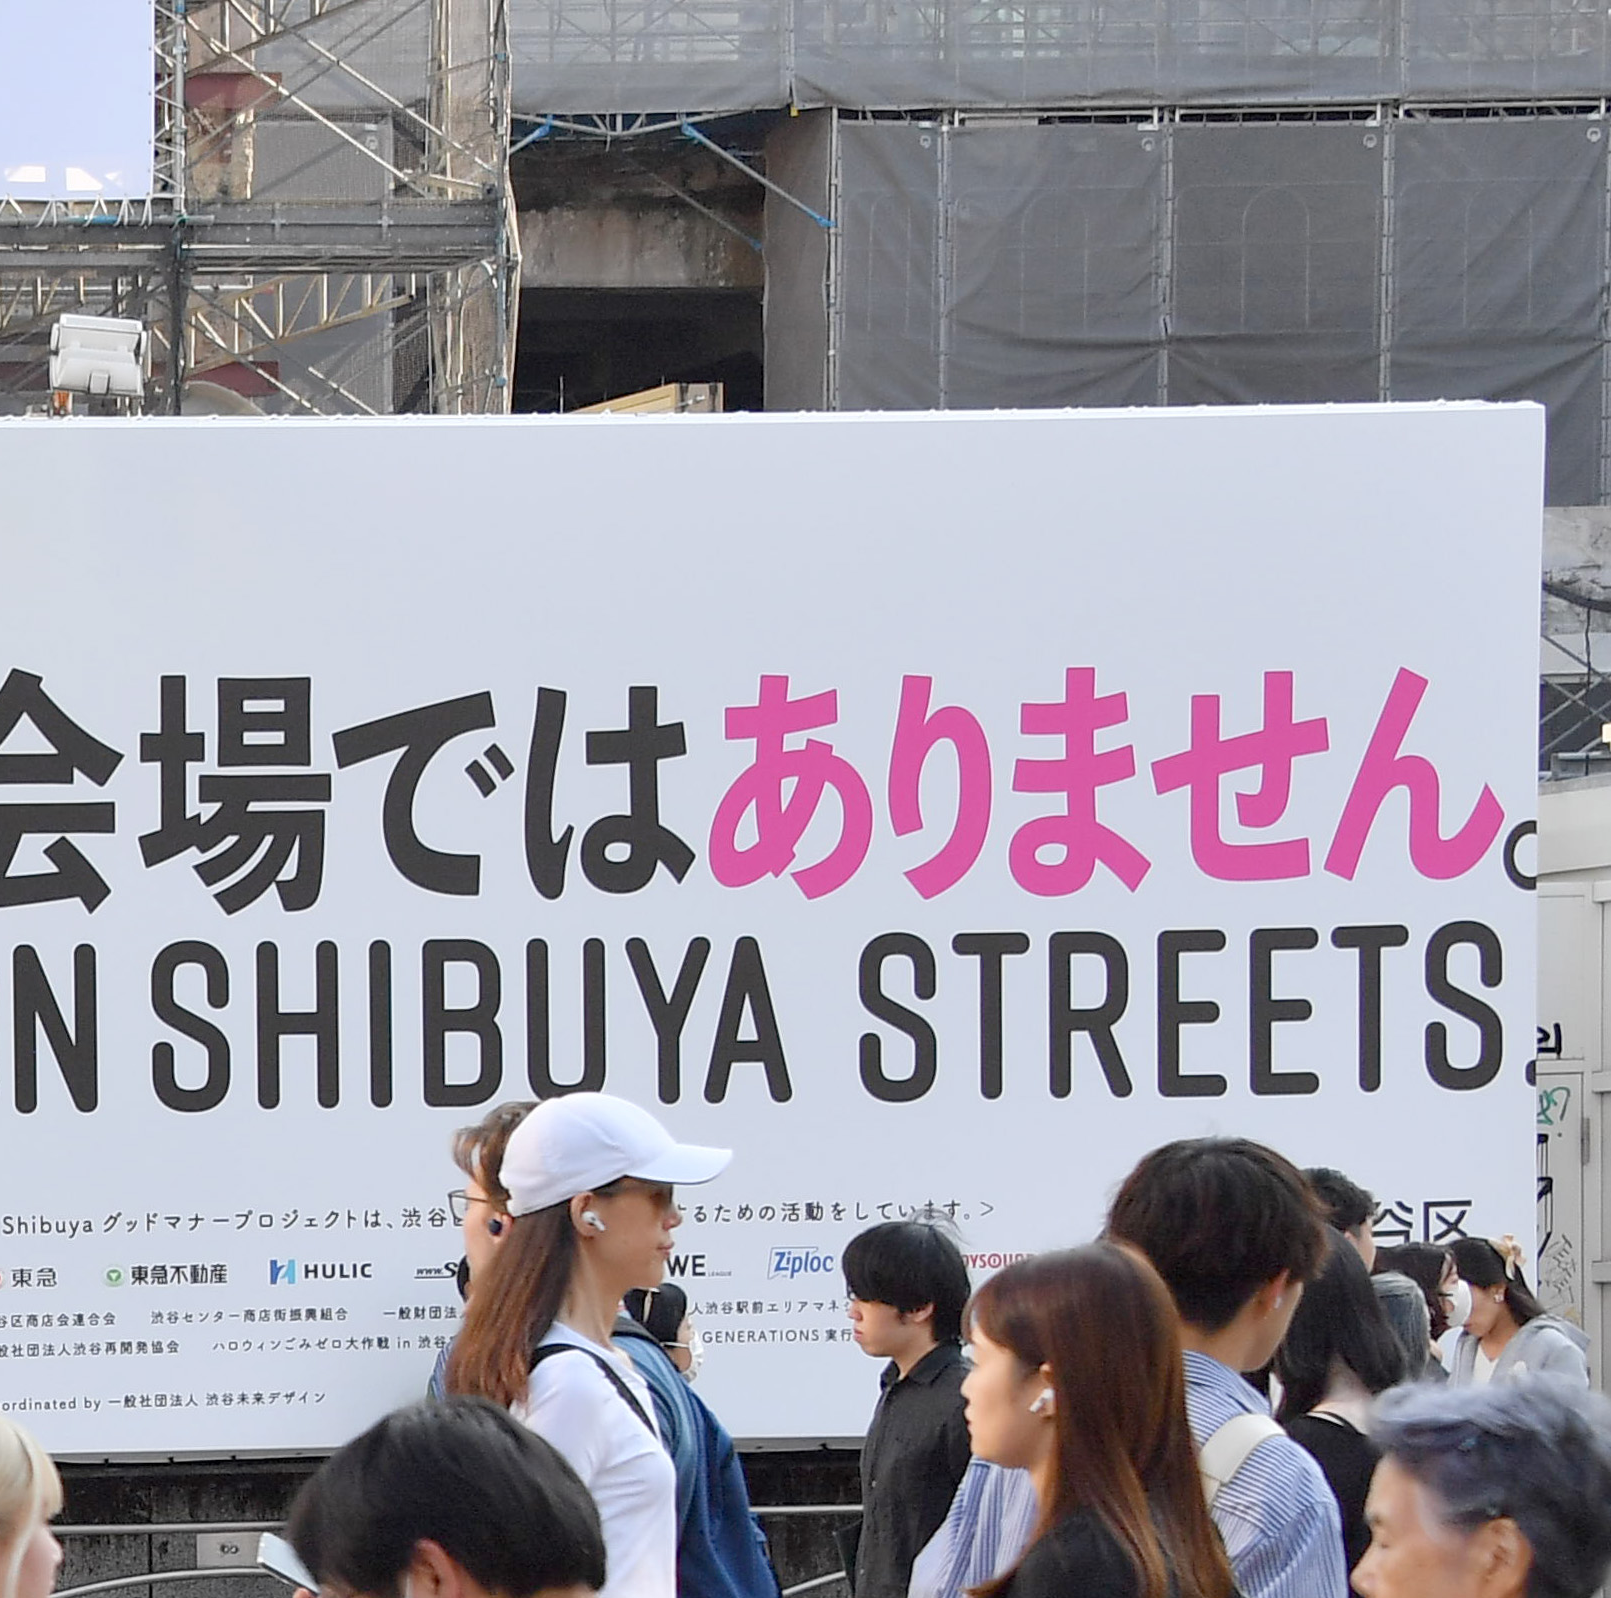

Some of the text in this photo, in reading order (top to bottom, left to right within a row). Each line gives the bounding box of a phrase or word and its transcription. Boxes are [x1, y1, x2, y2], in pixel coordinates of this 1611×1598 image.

[150, 935, 792, 1113] SHIBUYA
[1372, 1200, 1472, 1244] 谷区
[11, 1268, 58, 1288] 東急
[131, 1264, 228, 1285] 東急不動産
[304, 1263, 373, 1280] HULIC
[774, 1250, 834, 1279] Ziploc
[702, 1329, 820, 1344] GENERATIONS
[84, 1397, 102, 1411] by
